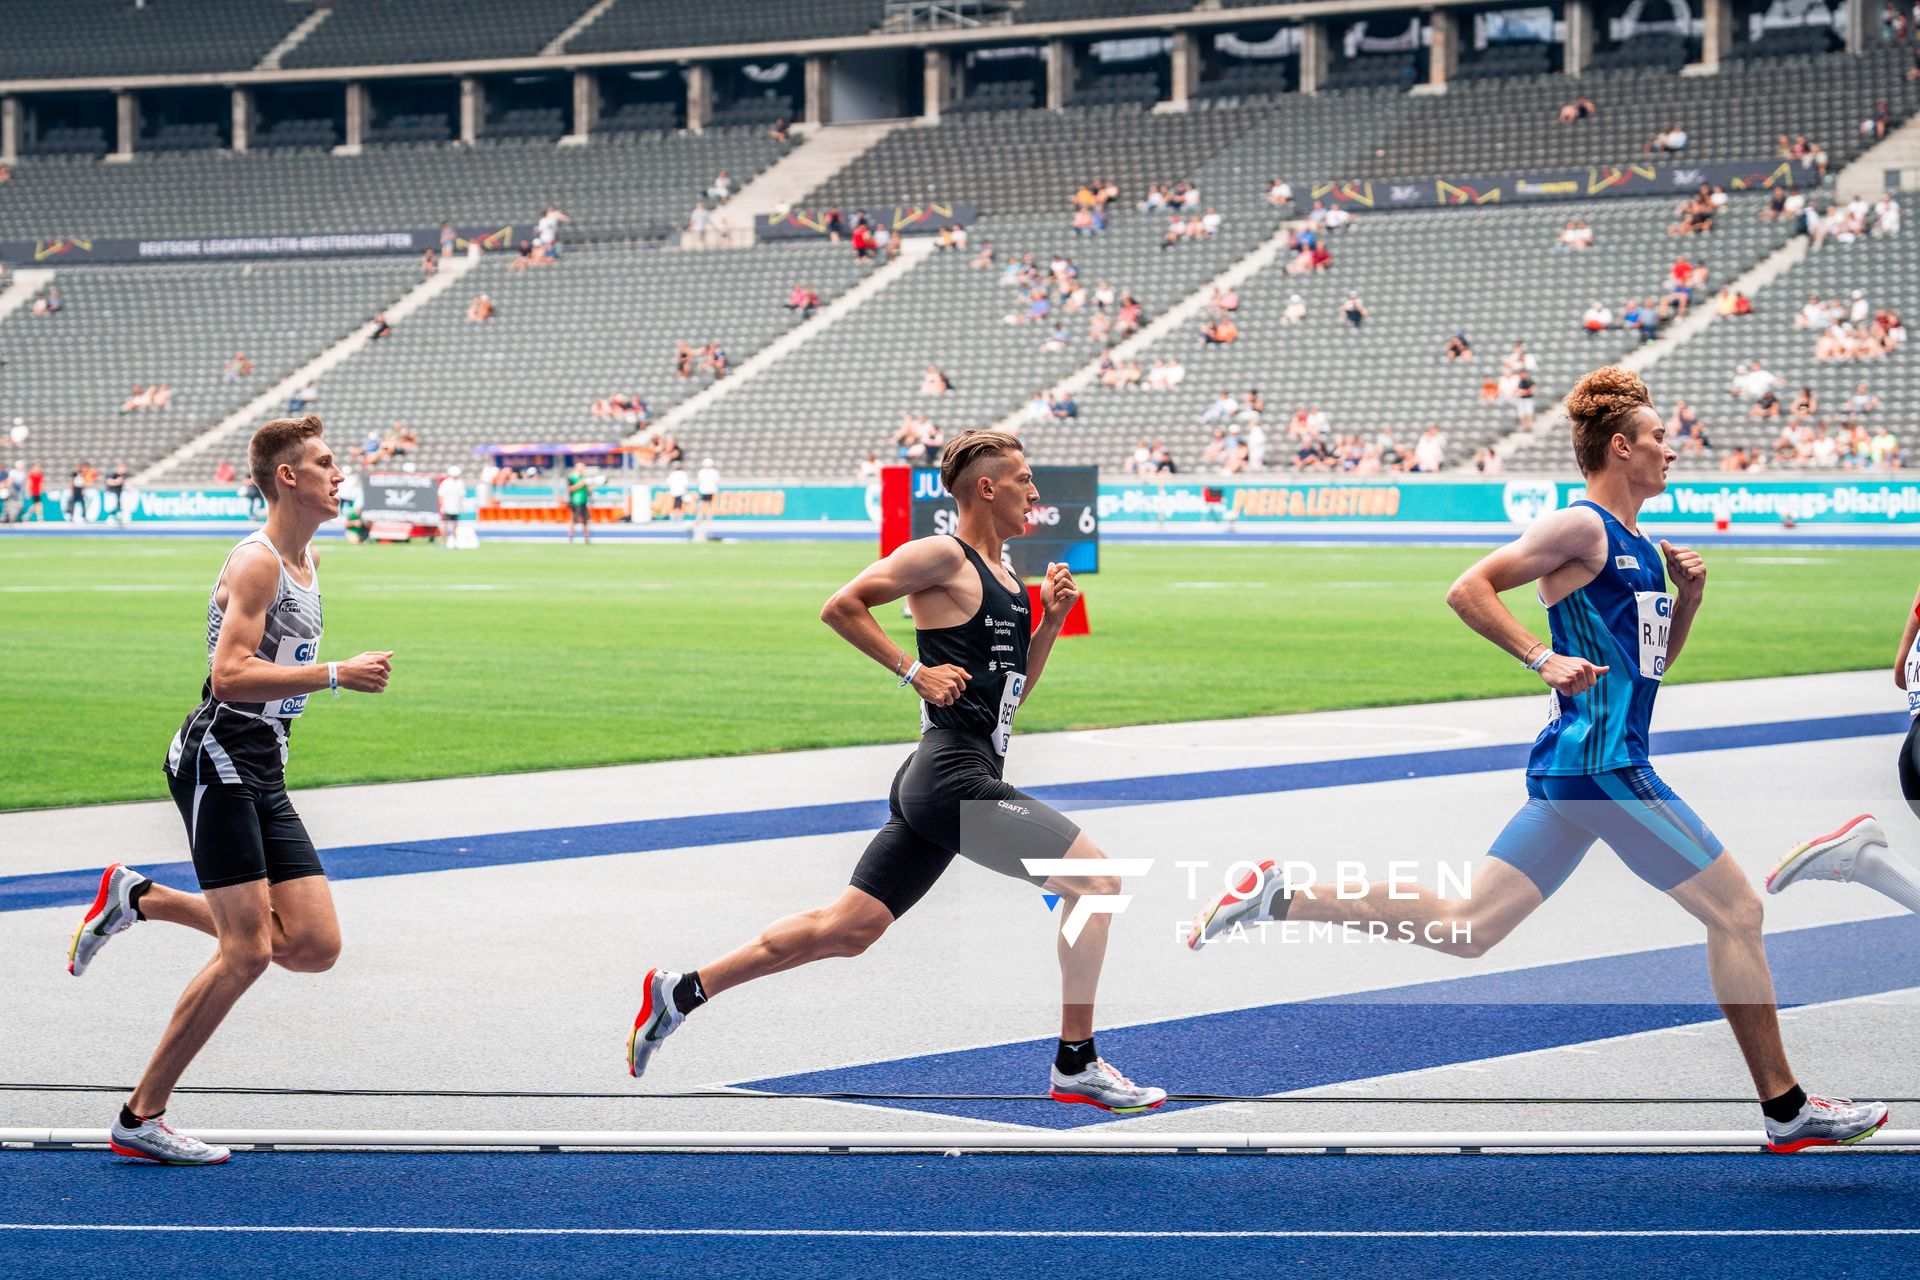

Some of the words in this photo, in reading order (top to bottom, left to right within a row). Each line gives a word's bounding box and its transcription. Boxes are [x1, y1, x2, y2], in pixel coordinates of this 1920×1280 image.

[139, 241, 201, 256] DEUTSCHE
[1079, 506, 1096, 534] 6
[995, 620, 1015, 628] Sparkasse
[995, 628, 1011, 636] Leipzig
[1643, 622, 1655, 647] R.
[998, 800, 1023, 813] CRAFT
